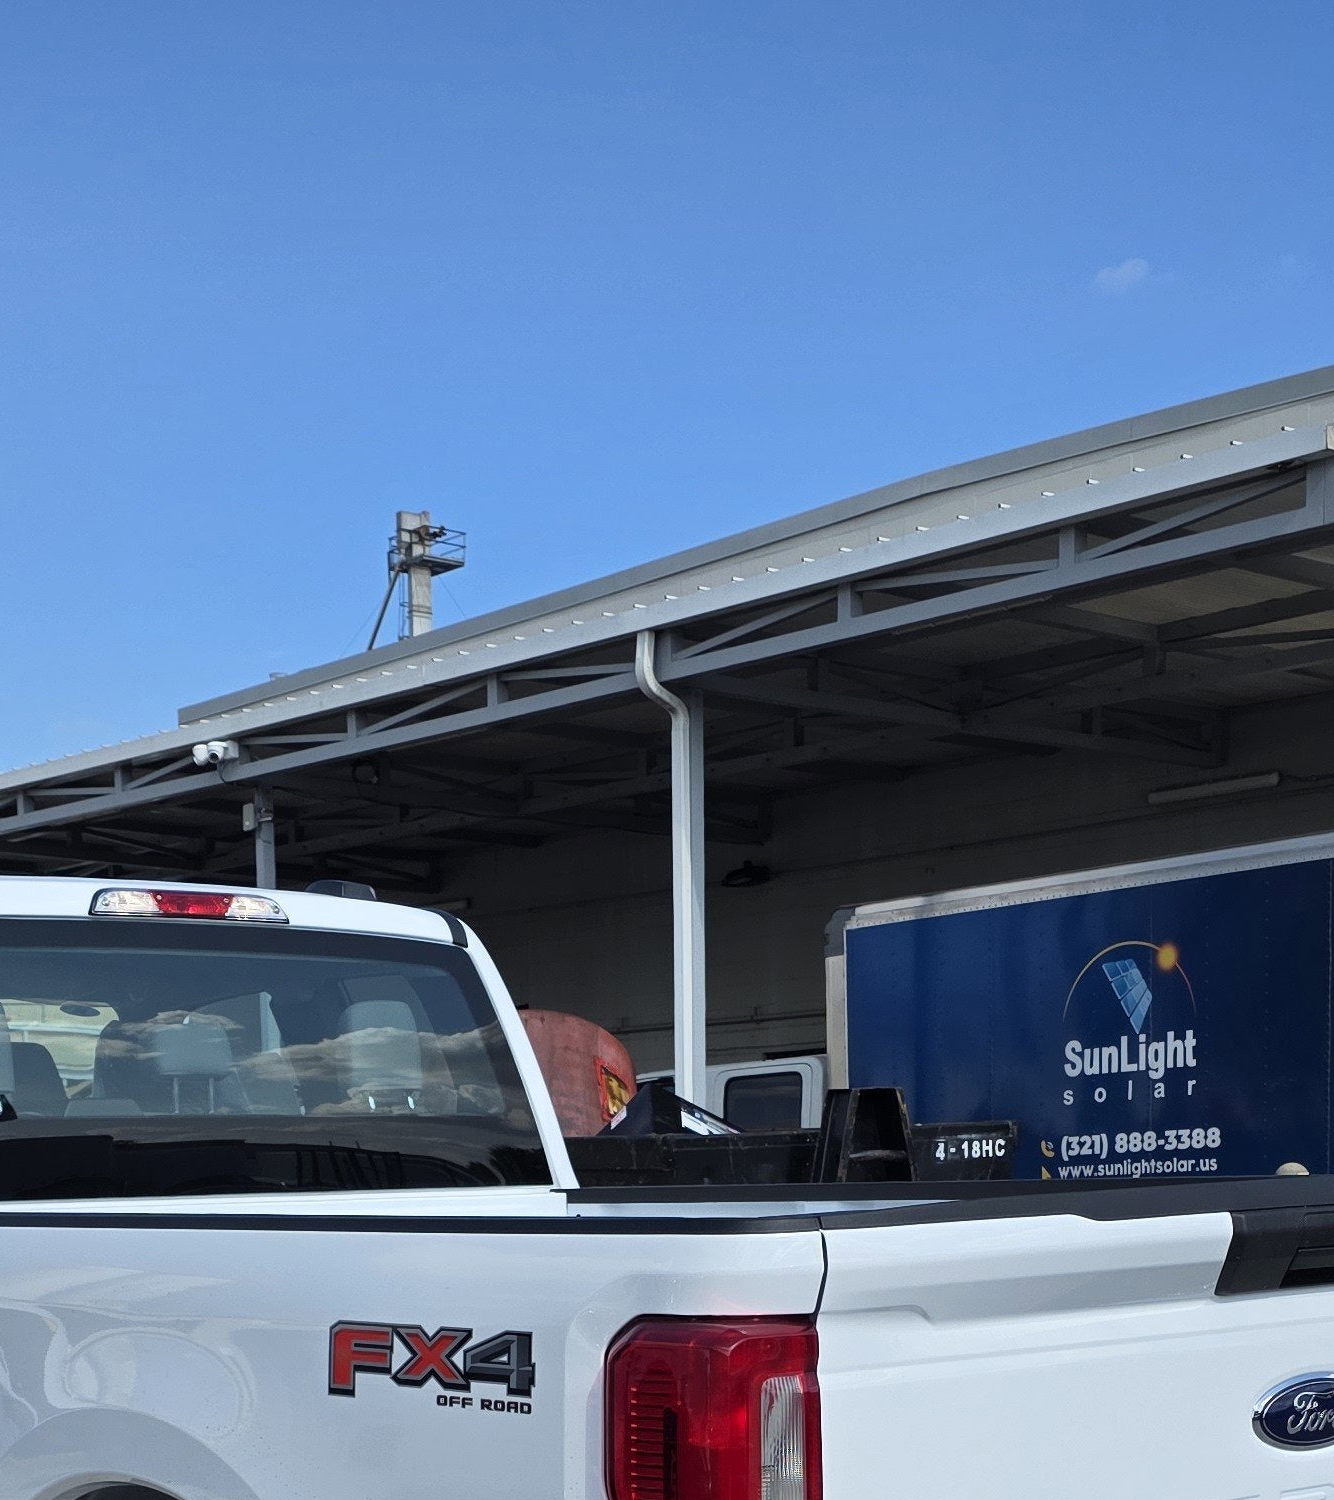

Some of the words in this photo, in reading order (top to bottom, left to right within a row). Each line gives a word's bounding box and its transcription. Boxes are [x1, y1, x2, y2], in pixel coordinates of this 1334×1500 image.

[1064, 1030, 1197, 1079] SunLight
[1063, 1080, 1196, 1105] solar
[1061, 1134, 1108, 1161] (321)
[1115, 1127, 1221, 1153] 888-3388
[1058, 1157, 1218, 1179] www.sunlightsolar.us
[328, 1320, 536, 1398] FX4
[436, 1394, 473, 1408] OFF
[480, 1398, 532, 1415] ROAD
